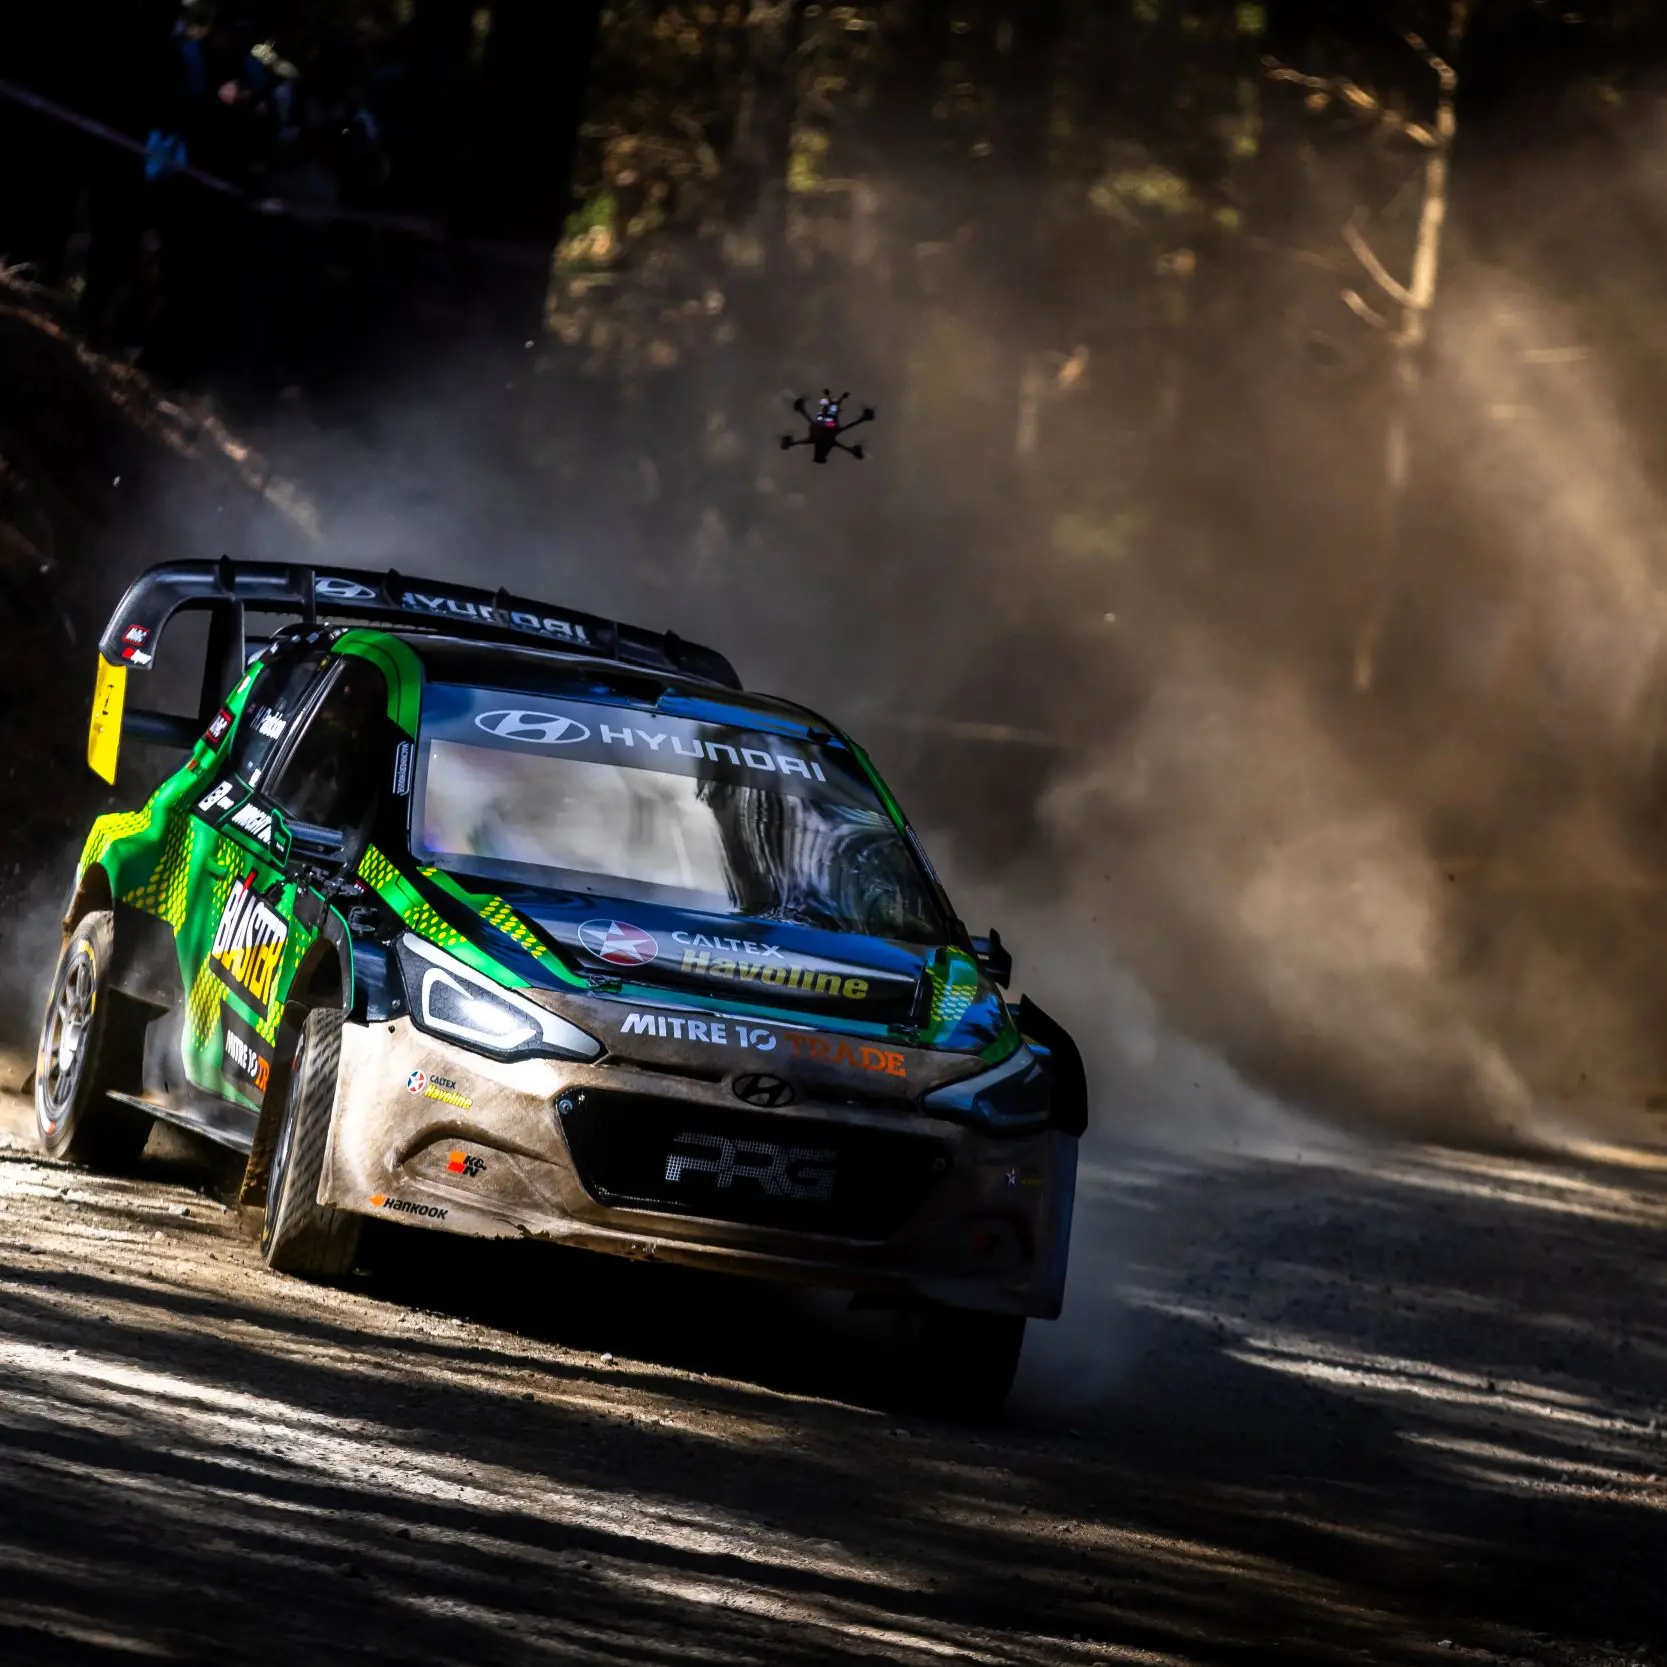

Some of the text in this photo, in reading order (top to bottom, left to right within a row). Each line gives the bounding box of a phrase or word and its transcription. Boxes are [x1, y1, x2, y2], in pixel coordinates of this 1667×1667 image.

[600, 724, 827, 782] HYUNDAI
[211, 879, 287, 1006] BLASTER
[671, 931, 785, 959] CALTEX
[681, 949, 869, 999] Havoline
[225, 1029, 248, 1069] MITRE
[247, 1048, 258, 1077] 10
[620, 1013, 906, 1077] MITRE 10 TRADE
[424, 1084, 473, 1110] Havoline
[429, 1075, 457, 1090] CALTEX
[665, 1131, 837, 1201] PRG
